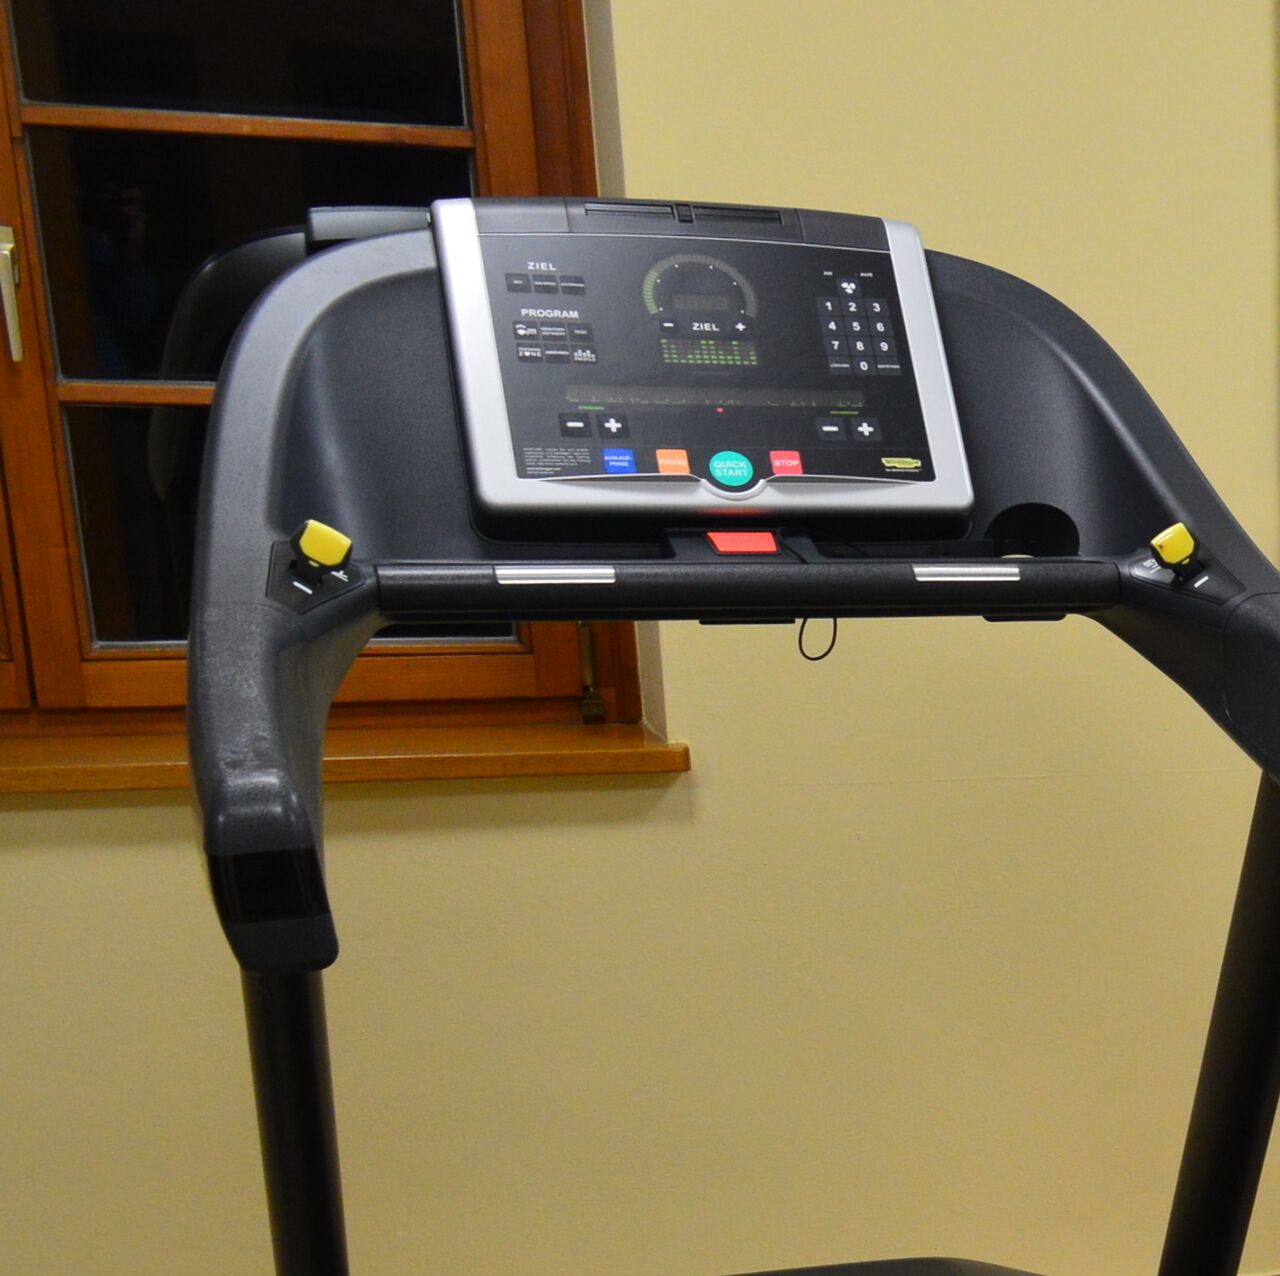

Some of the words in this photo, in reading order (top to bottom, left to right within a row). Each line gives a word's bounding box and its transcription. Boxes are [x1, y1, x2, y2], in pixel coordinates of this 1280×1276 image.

[527, 261, 557, 271] ZIEL
[825, 301, 832, 311] 1
[848, 302, 857, 312] 2
[872, 302, 881, 312] 3
[520, 308, 579, 319] PROGRAM
[691, 322, 720, 331] ZIEL
[828, 321, 837, 331] 4
[852, 321, 861, 331] 5
[876, 322, 885, 332] 6
[831, 340, 839, 350] 7
[856, 341, 865, 351] 8
[880, 341, 889, 352] 9
[859, 361, 869, 371] 0
[713, 460, 746, 468] QUICK
[715, 468, 748, 476] START
